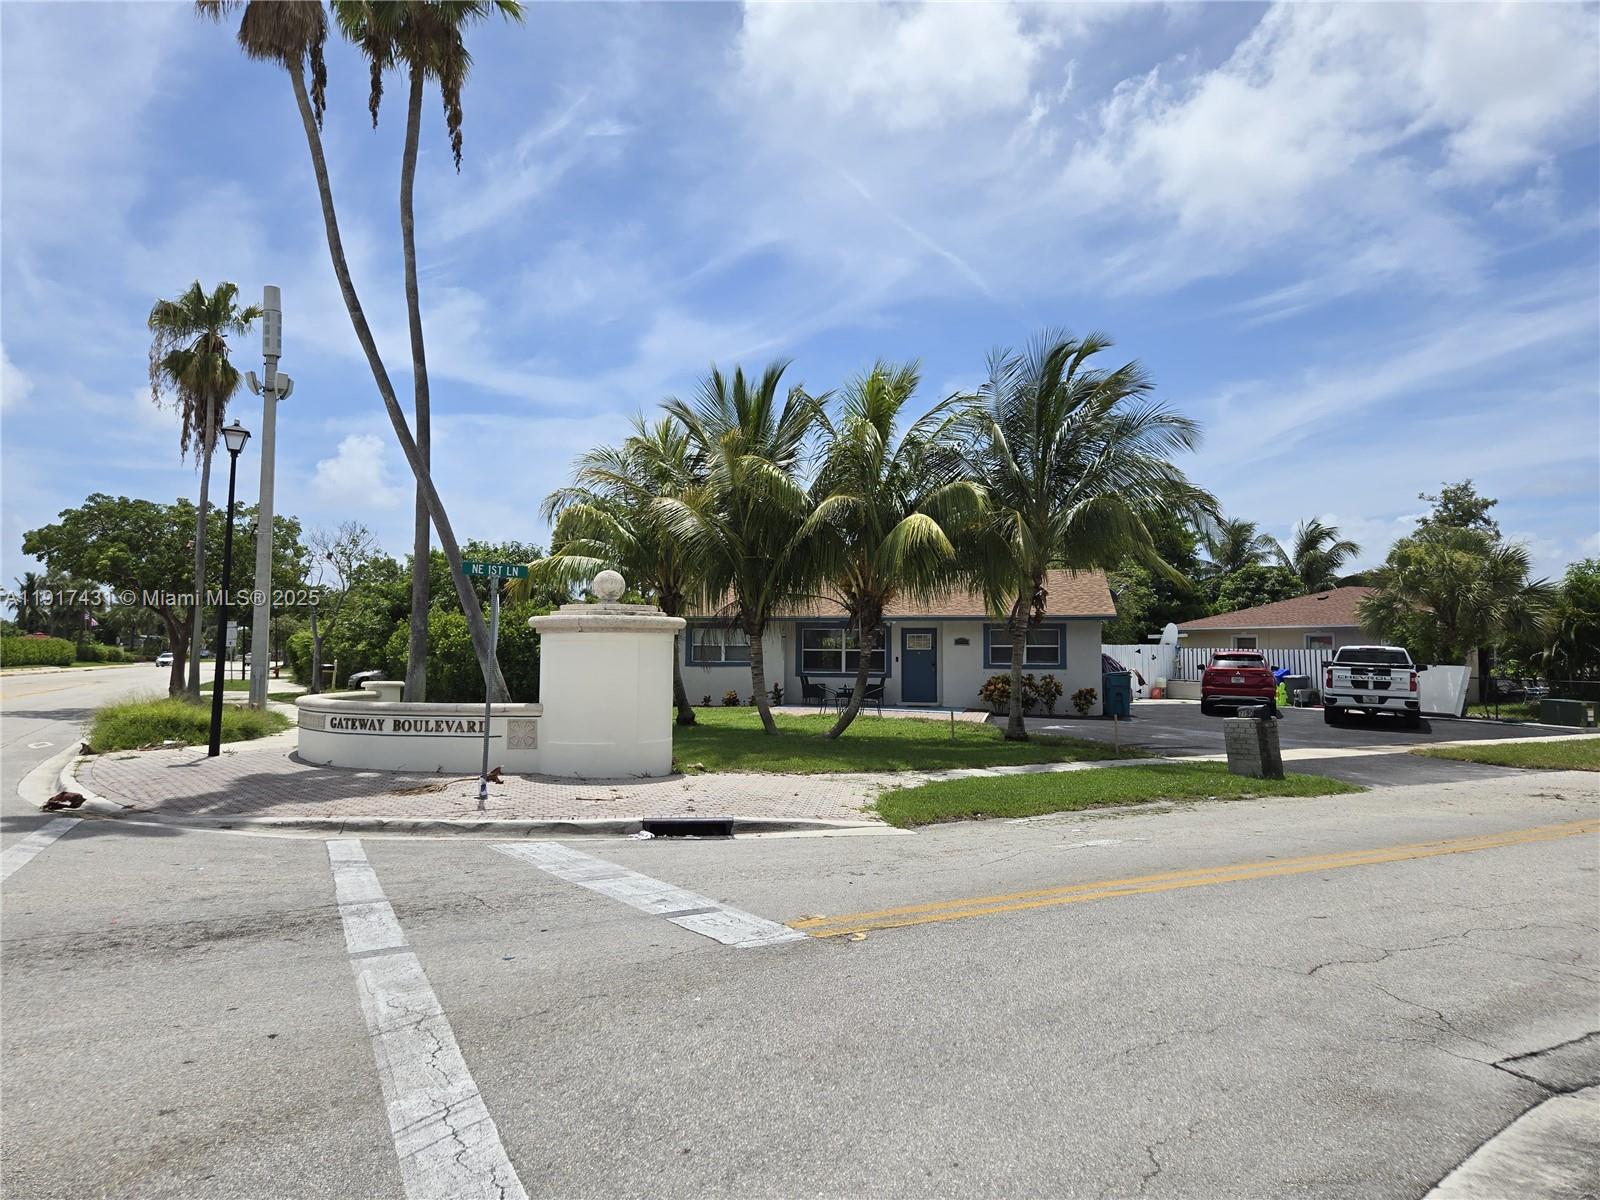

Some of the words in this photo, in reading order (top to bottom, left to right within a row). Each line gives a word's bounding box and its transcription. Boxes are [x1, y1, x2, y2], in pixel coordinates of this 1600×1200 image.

[472, 564, 484, 574] NE
[506, 566, 519, 577] LN
[330, 717, 385, 731] GATEWAY
